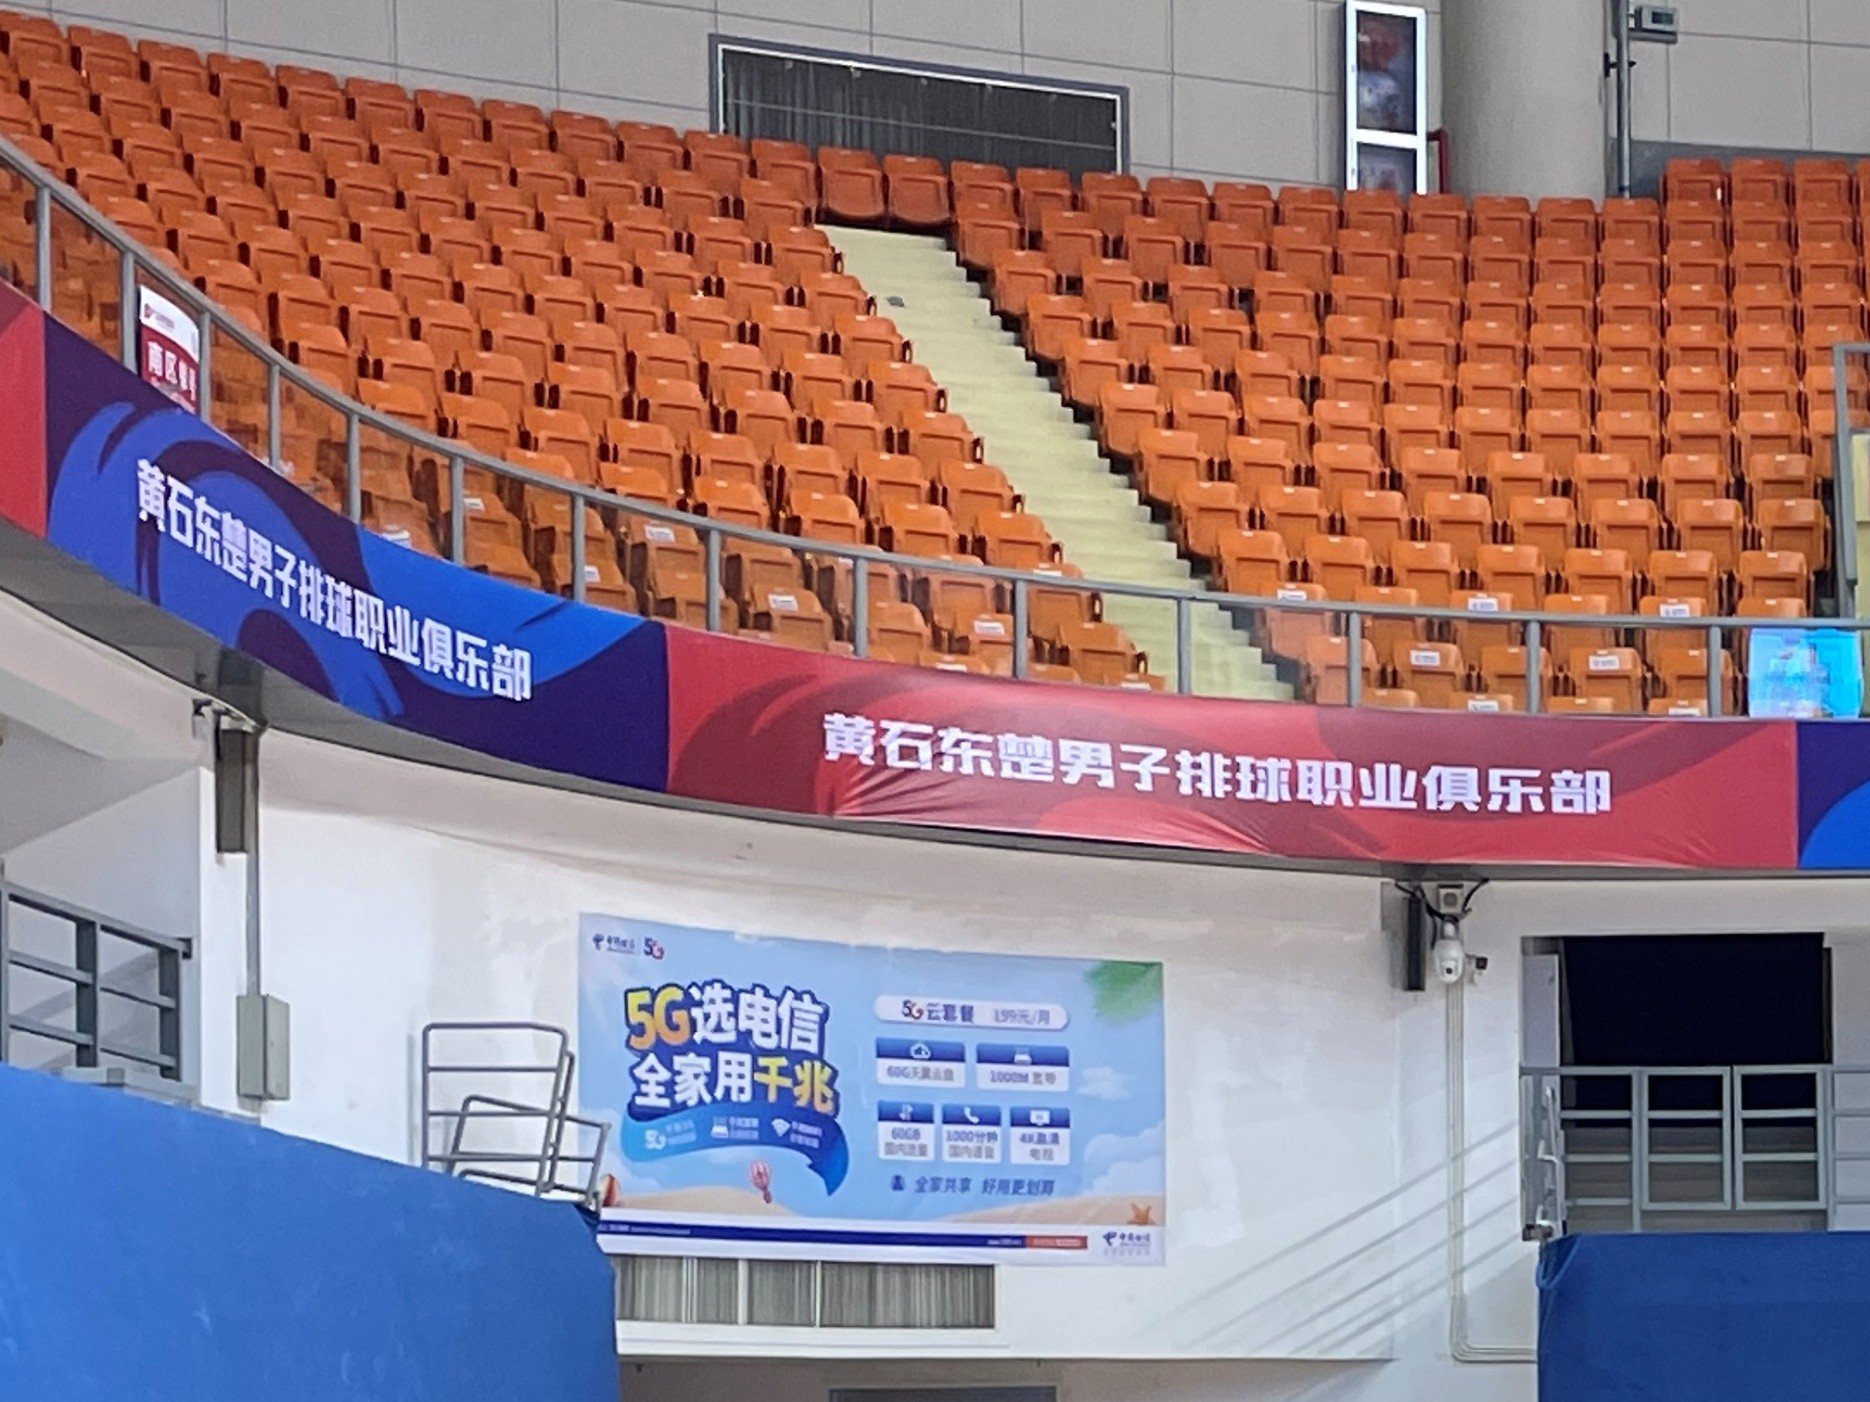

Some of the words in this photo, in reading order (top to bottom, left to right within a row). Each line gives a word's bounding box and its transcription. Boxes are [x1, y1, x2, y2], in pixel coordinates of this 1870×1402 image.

[137, 459, 532, 701] 黄石东楚男子排球职业俱乐部
[822, 712, 1612, 815] 黄石东楚男子排球职业俱乐部
[626, 982, 824, 1054] 5G选电信
[632, 1051, 834, 1114] 全家用千兆
